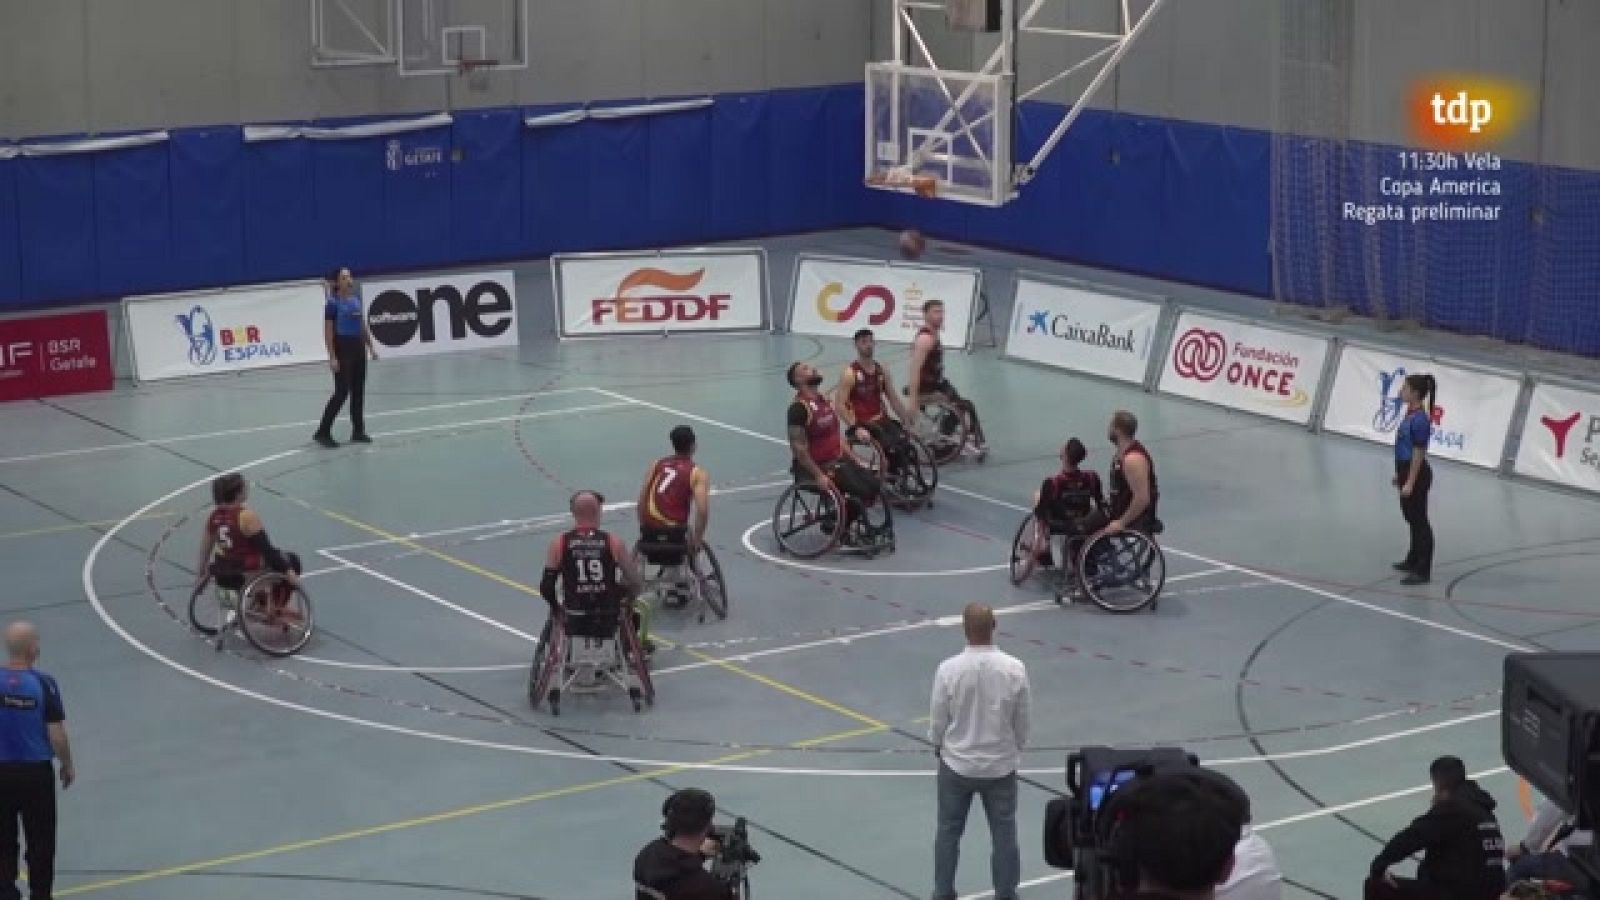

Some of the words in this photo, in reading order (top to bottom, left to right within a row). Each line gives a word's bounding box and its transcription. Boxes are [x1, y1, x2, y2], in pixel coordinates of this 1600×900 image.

[592, 294, 731, 325] FEDDF
[1051, 313, 1135, 353] CaixaBank
[49, 355, 97, 371] Getafe
[1232, 342, 1299, 368] Fundación
[1226, 361, 1295, 396] ONCE
[658, 467, 677, 493] 7
[218, 526, 232, 548] 5
[576, 559, 604, 582] 19
